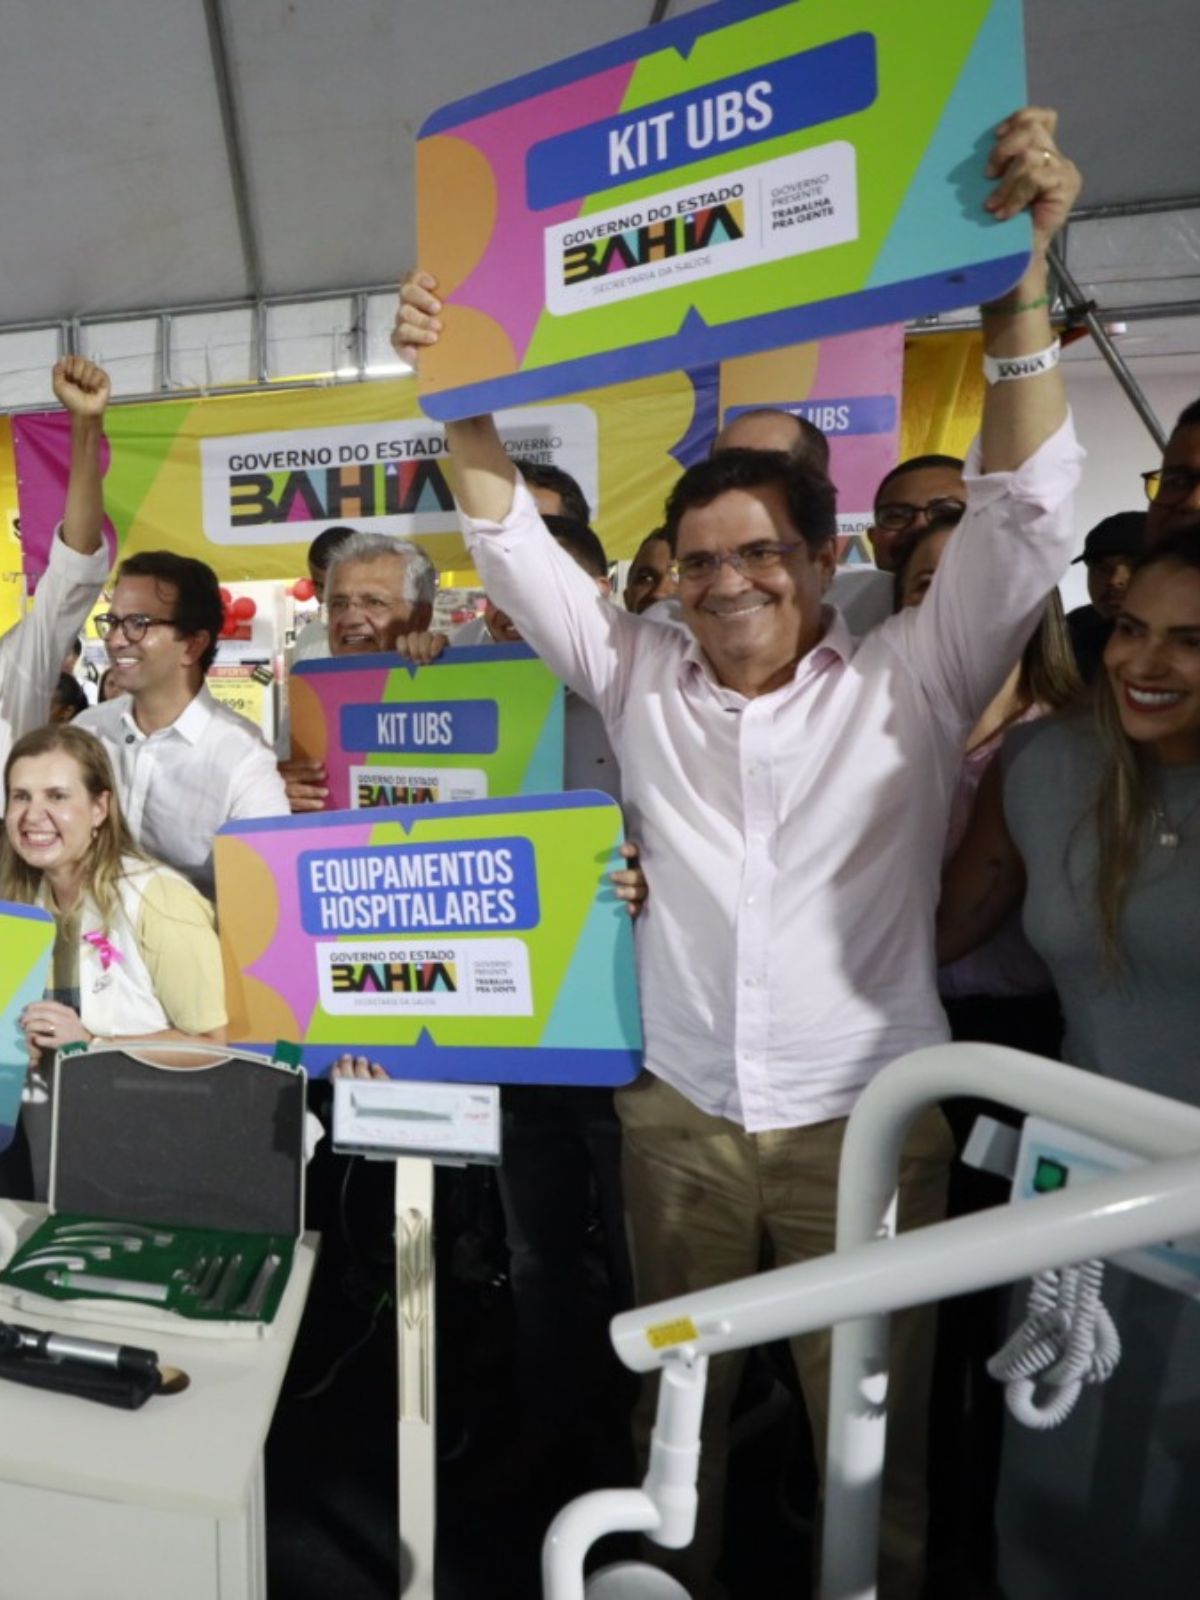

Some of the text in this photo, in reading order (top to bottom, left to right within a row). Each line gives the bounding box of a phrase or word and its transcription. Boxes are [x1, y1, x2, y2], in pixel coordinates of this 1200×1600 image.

[609, 81, 773, 176] KIT UBS
[563, 184, 744, 247] GOVERNO DO ESTADO
[772, 197, 831, 219] TRABALHA
[772, 205, 834, 231] PRA GENTE
[564, 200, 745, 286] BAHIA
[592, 271, 656, 295] SECRETARIA
[658, 265, 673, 277] DA
[229, 448, 332, 472] GOVERNO
[339, 443, 370, 463] DO
[503, 437, 562, 452] OVERNO
[229, 459, 456, 527] BAHIA
[377, 711, 453, 746] KIT UBS
[310, 849, 514, 896] EQUIPAMENTOS
[320, 889, 517, 930] HOSPITALARES
[330, 950, 455, 962] GOVERNO DO ESTADO
[331, 962, 457, 993] BAHIA
